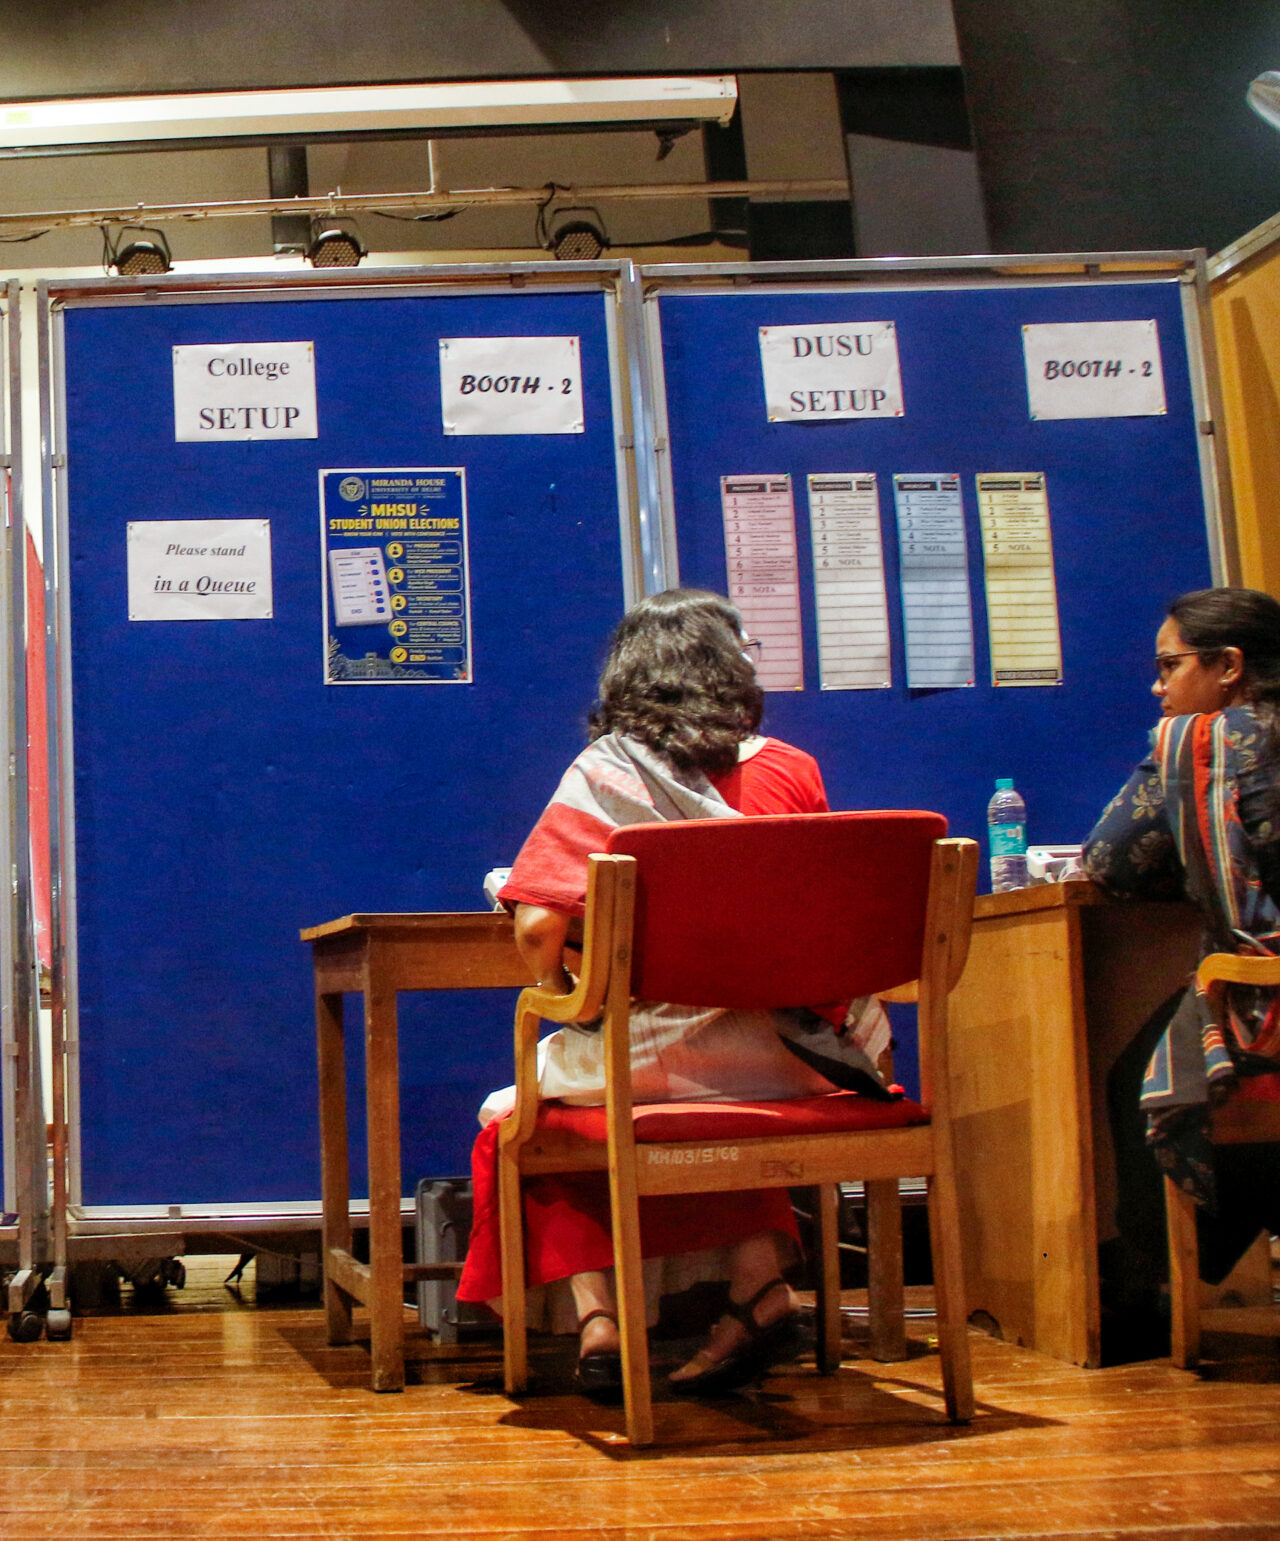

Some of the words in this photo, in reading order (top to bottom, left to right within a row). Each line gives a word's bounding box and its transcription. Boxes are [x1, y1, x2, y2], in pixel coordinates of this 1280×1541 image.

[793, 335, 872, 357] DUSU
[208, 358, 289, 380] College
[1044, 360, 1121, 380] BOOTH
[1142, 361, 1152, 377] 2
[460, 375, 540, 395] BOOTH
[561, 378, 571, 394] 2
[790, 389, 886, 412] SETUP
[200, 407, 299, 429] SETUP
[372, 479, 413, 487] MIRANDA
[415, 478, 446, 486] HOUSE
[371, 504, 417, 516] MHSU
[329, 519, 374, 530] STUDENT
[376, 518, 407, 530] UNION
[410, 518, 459, 529] ELECTIONS
[166, 544, 207, 555] Please
[211, 545, 246, 556] stand
[154, 575, 175, 593] in
[179, 581, 189, 591] a
[194, 575, 256, 597] Queue
